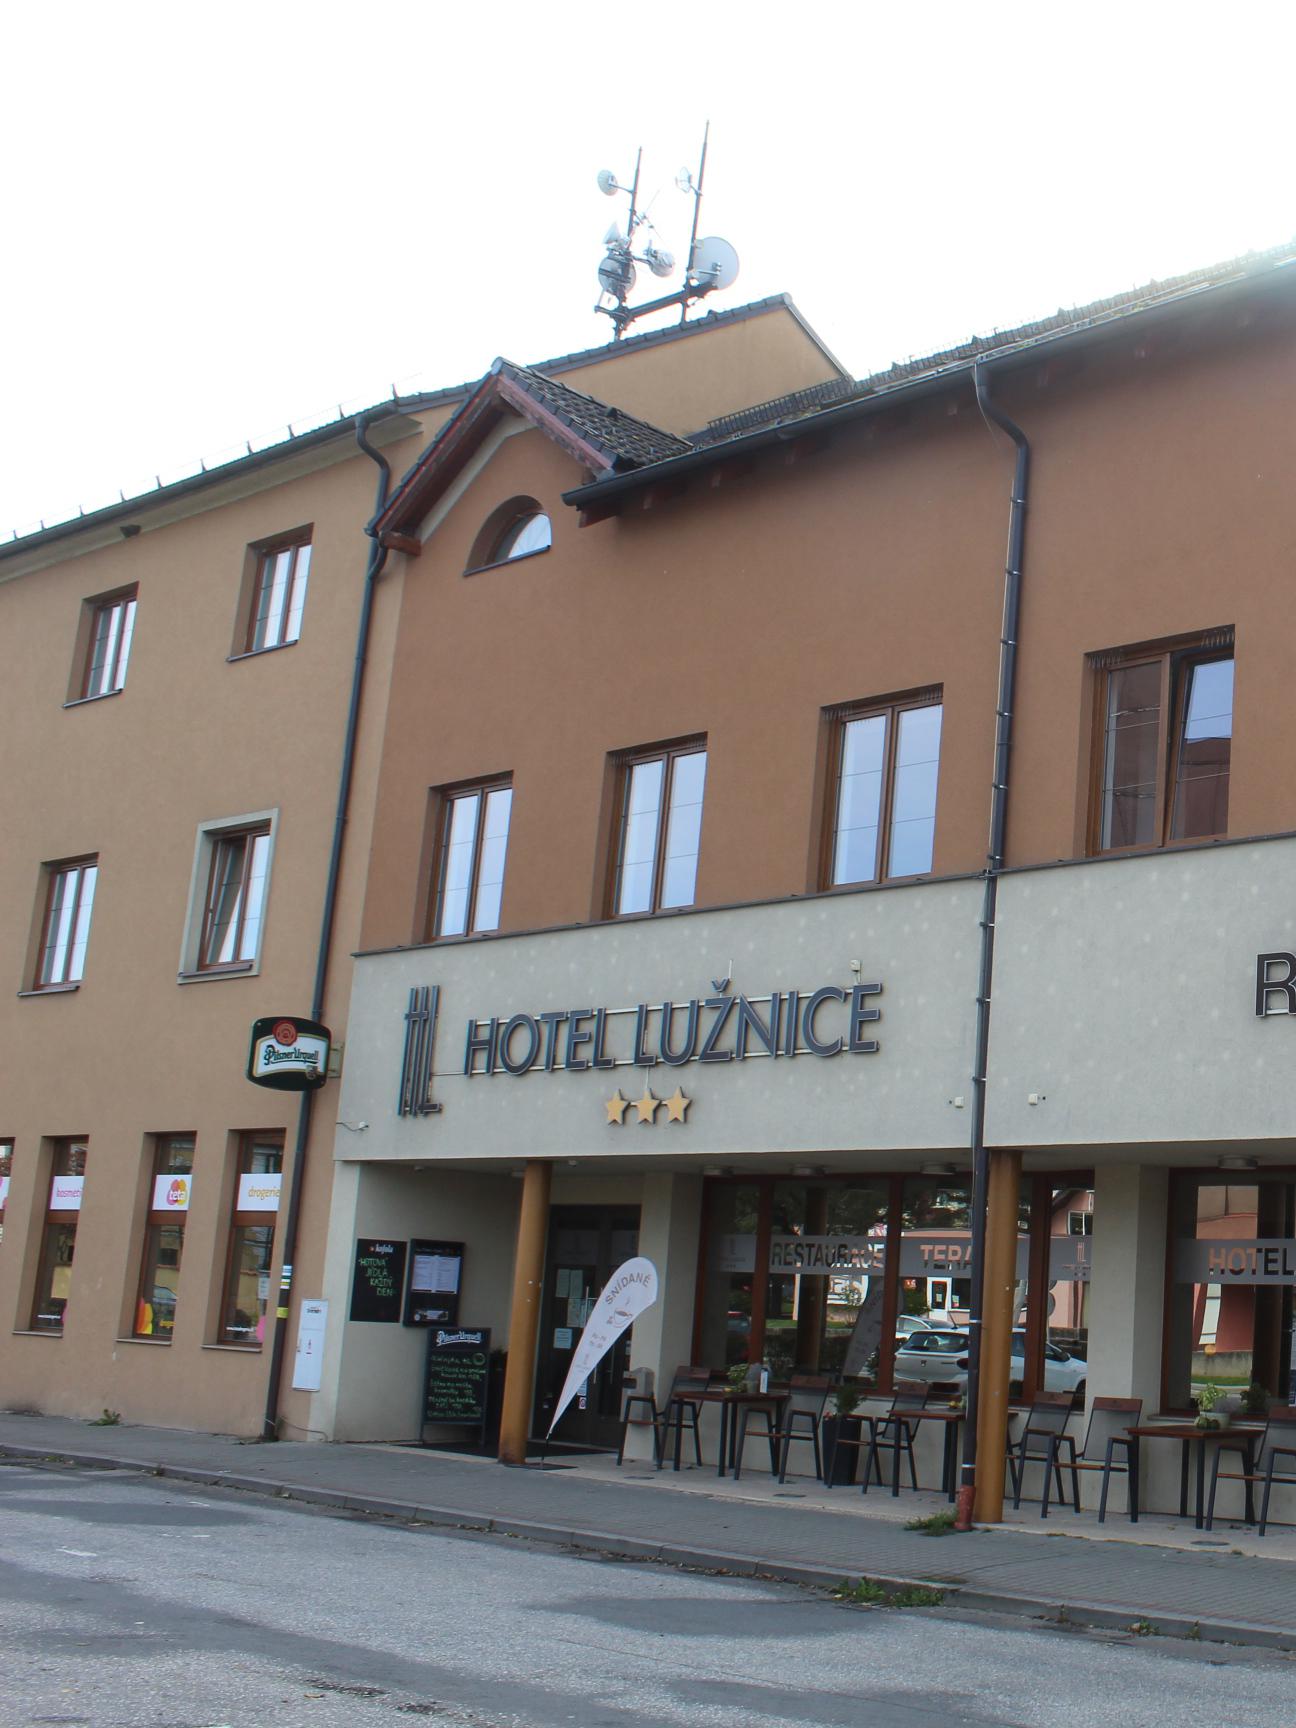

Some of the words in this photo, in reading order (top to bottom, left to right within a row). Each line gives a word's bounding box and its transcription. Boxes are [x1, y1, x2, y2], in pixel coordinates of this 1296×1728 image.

[463, 1007, 616, 1077] HOTEL
[632, 978, 883, 1068] LUŽNICE
[263, 1044, 295, 1065] Pilsner
[294, 1047, 320, 1063] Urquell
[168, 1188, 188, 1201] teta
[771, 1242, 886, 1269] RESTAURACE
[1208, 1247, 1296, 1277] HOTEL
